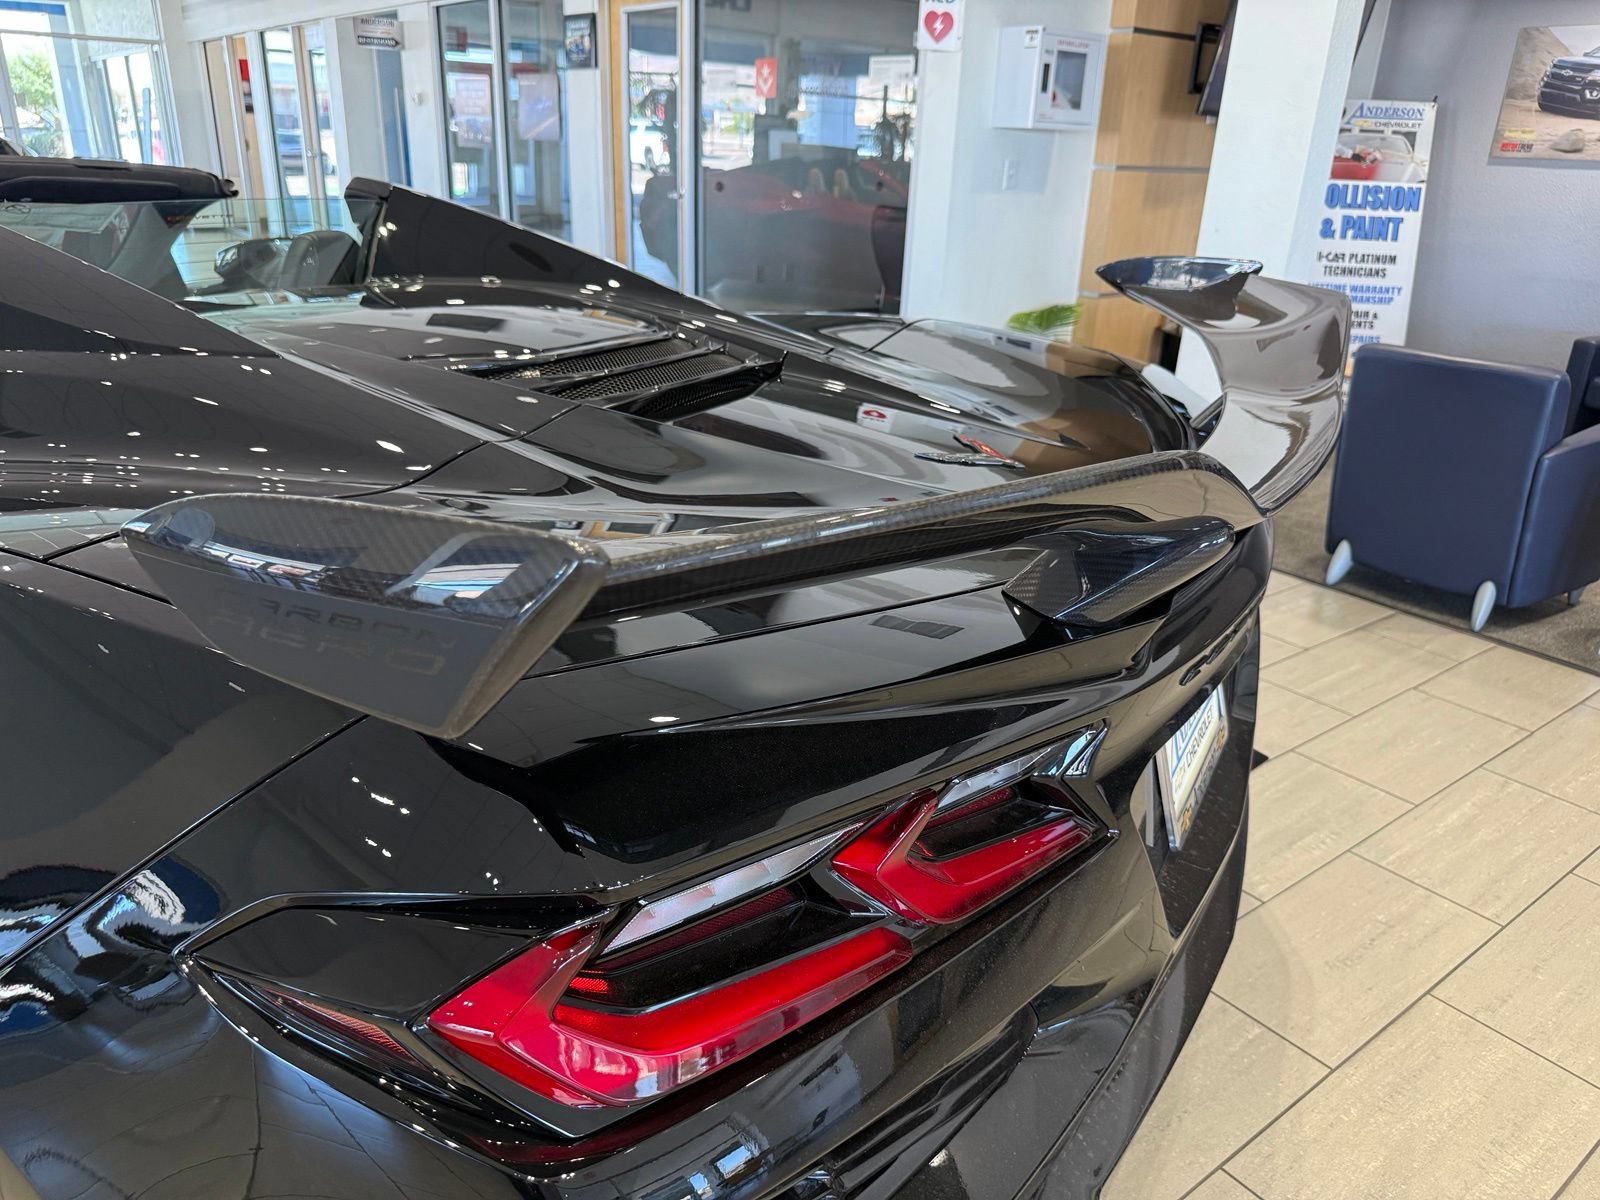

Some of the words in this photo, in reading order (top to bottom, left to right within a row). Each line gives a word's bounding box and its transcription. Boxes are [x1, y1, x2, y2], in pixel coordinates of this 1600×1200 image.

[1345, 102, 1424, 125] ANDERSON
[1374, 121, 1422, 129] CHEVROLET
[1324, 183, 1422, 212] OLLISION
[1319, 217, 1335, 239] &
[1339, 215, 1404, 242] PAINT
[1348, 253, 1397, 265] PLATINUM
[1323, 265, 1387, 278] TECHNICIANS
[1349, 285, 1402, 296] WARRANTY
[1350, 295, 1394, 305] MANSHIP
